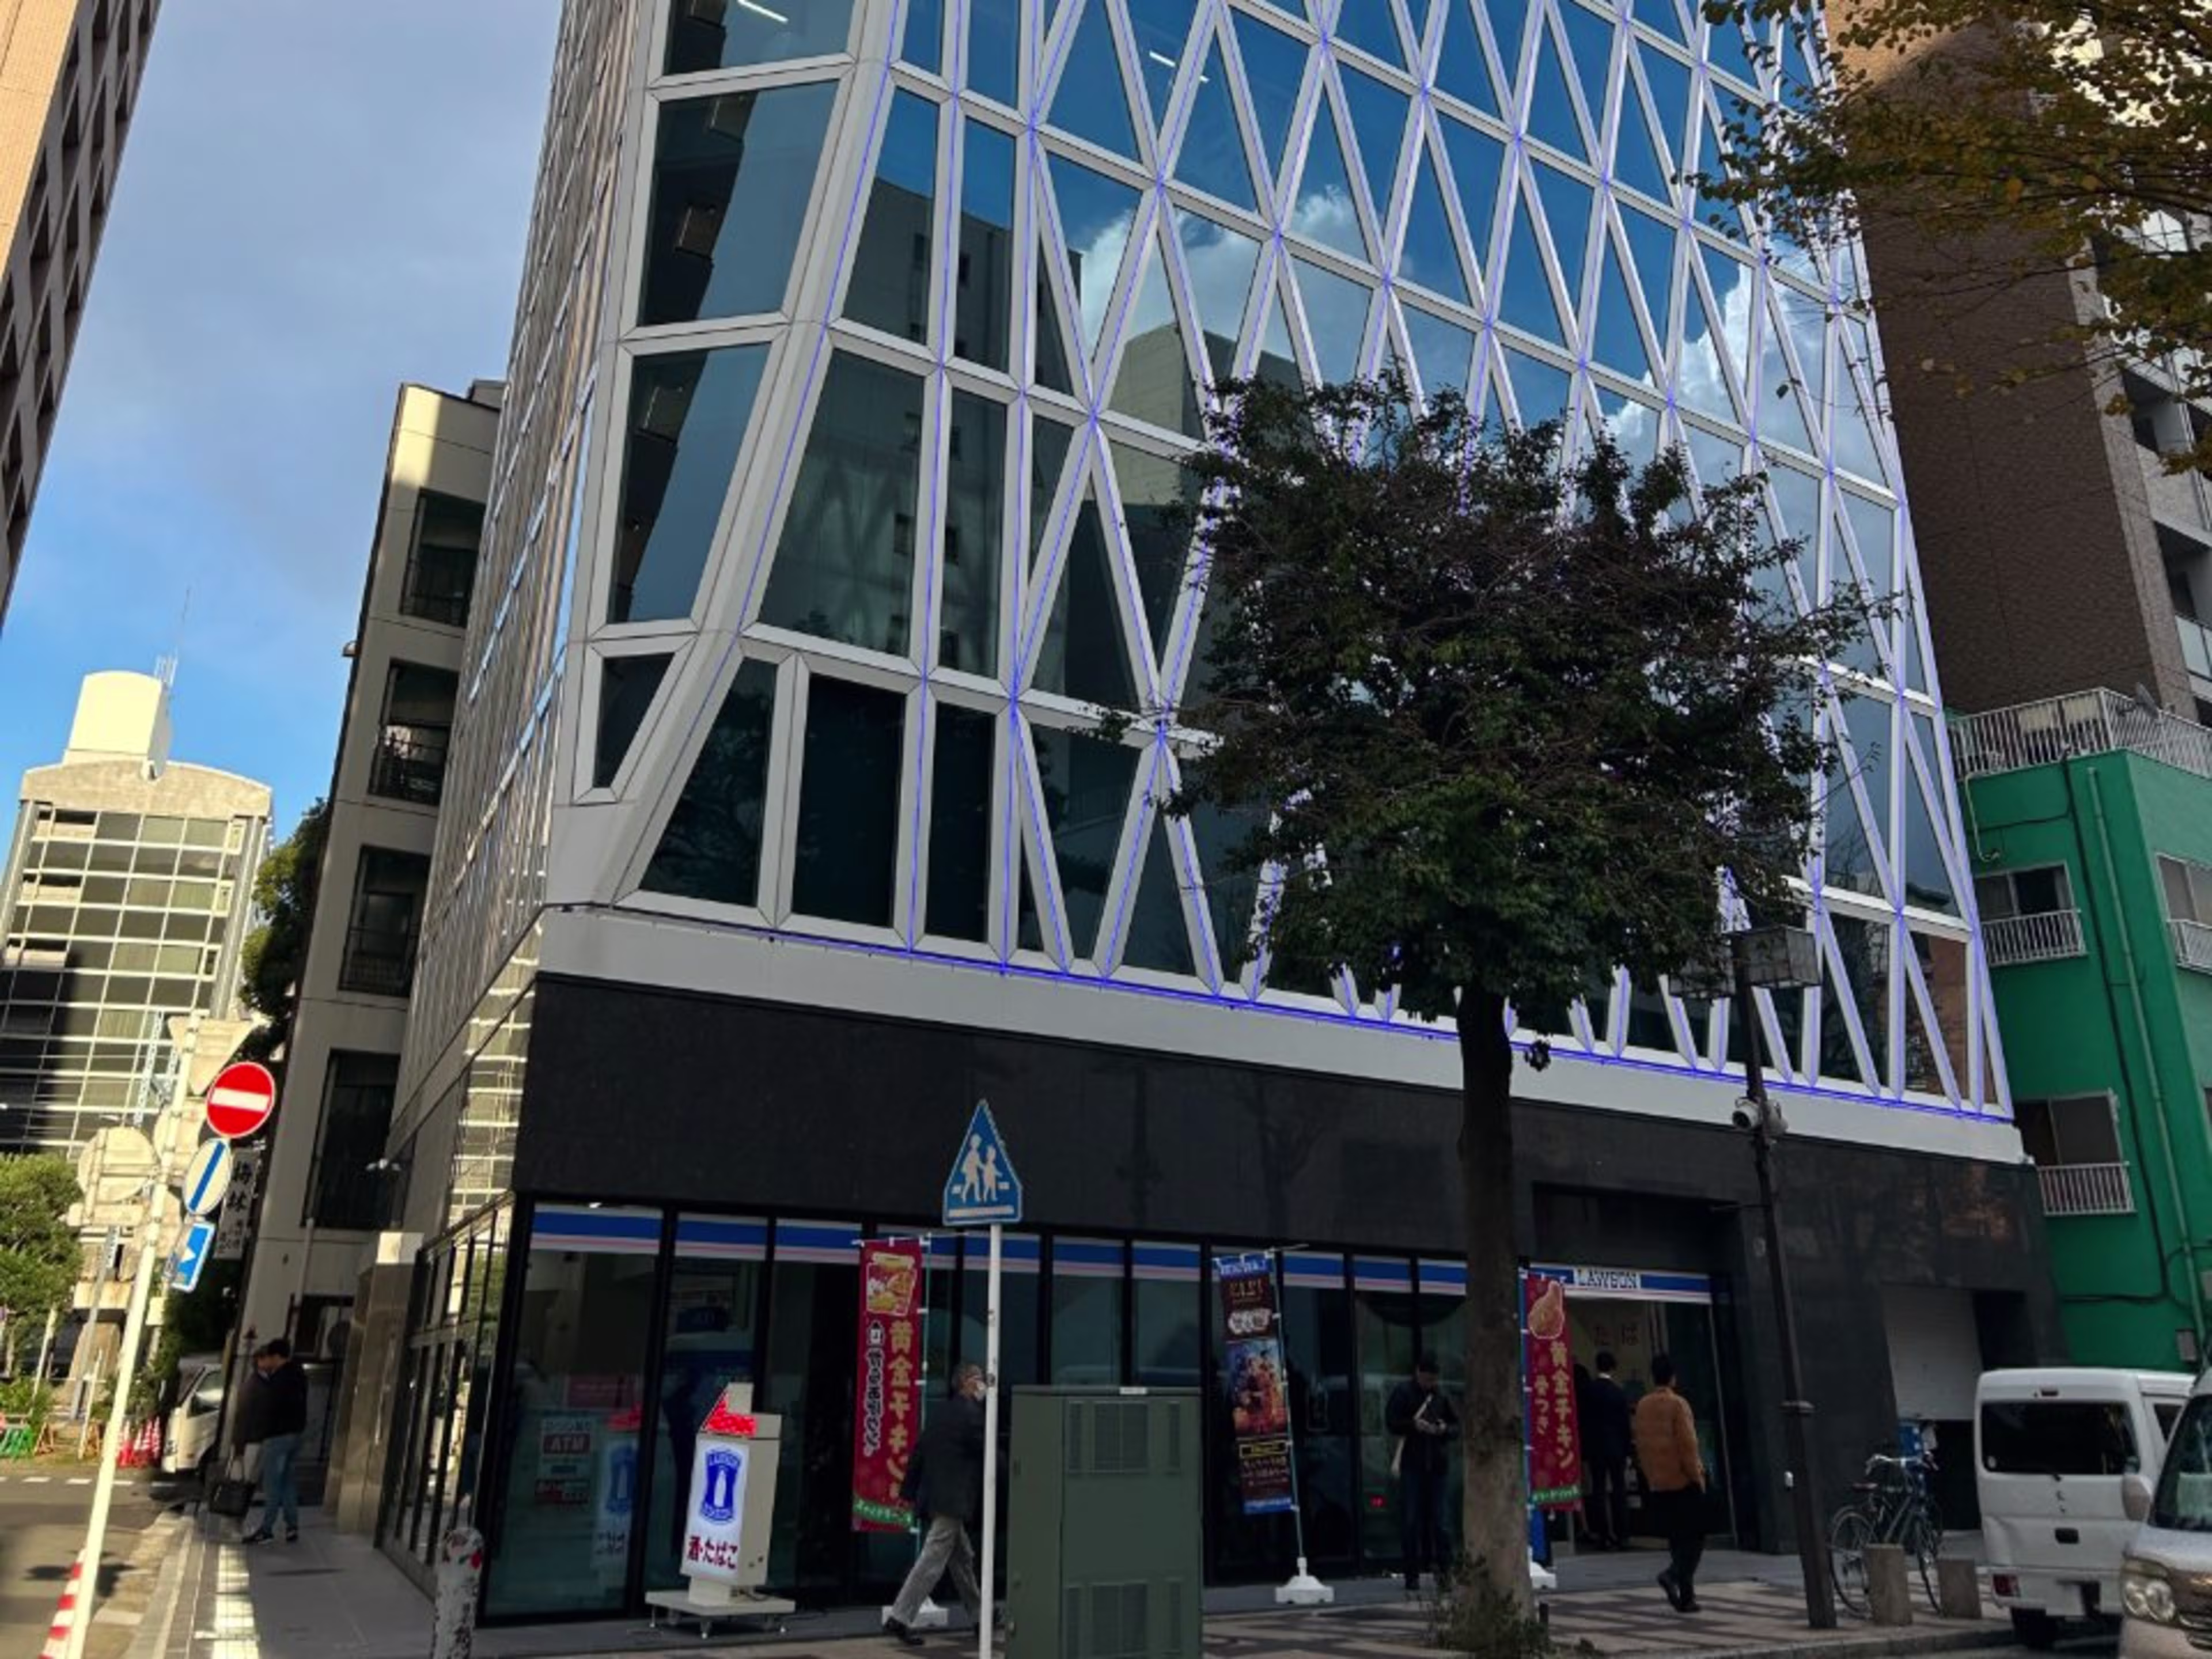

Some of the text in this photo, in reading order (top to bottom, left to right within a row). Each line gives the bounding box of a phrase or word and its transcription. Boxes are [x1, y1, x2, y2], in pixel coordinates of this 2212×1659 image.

[1578, 1268, 1637, 1289] LAWSON
[1551, 1340, 1574, 1468] 黄金チキン
[550, 1435, 586, 1453] ATM
